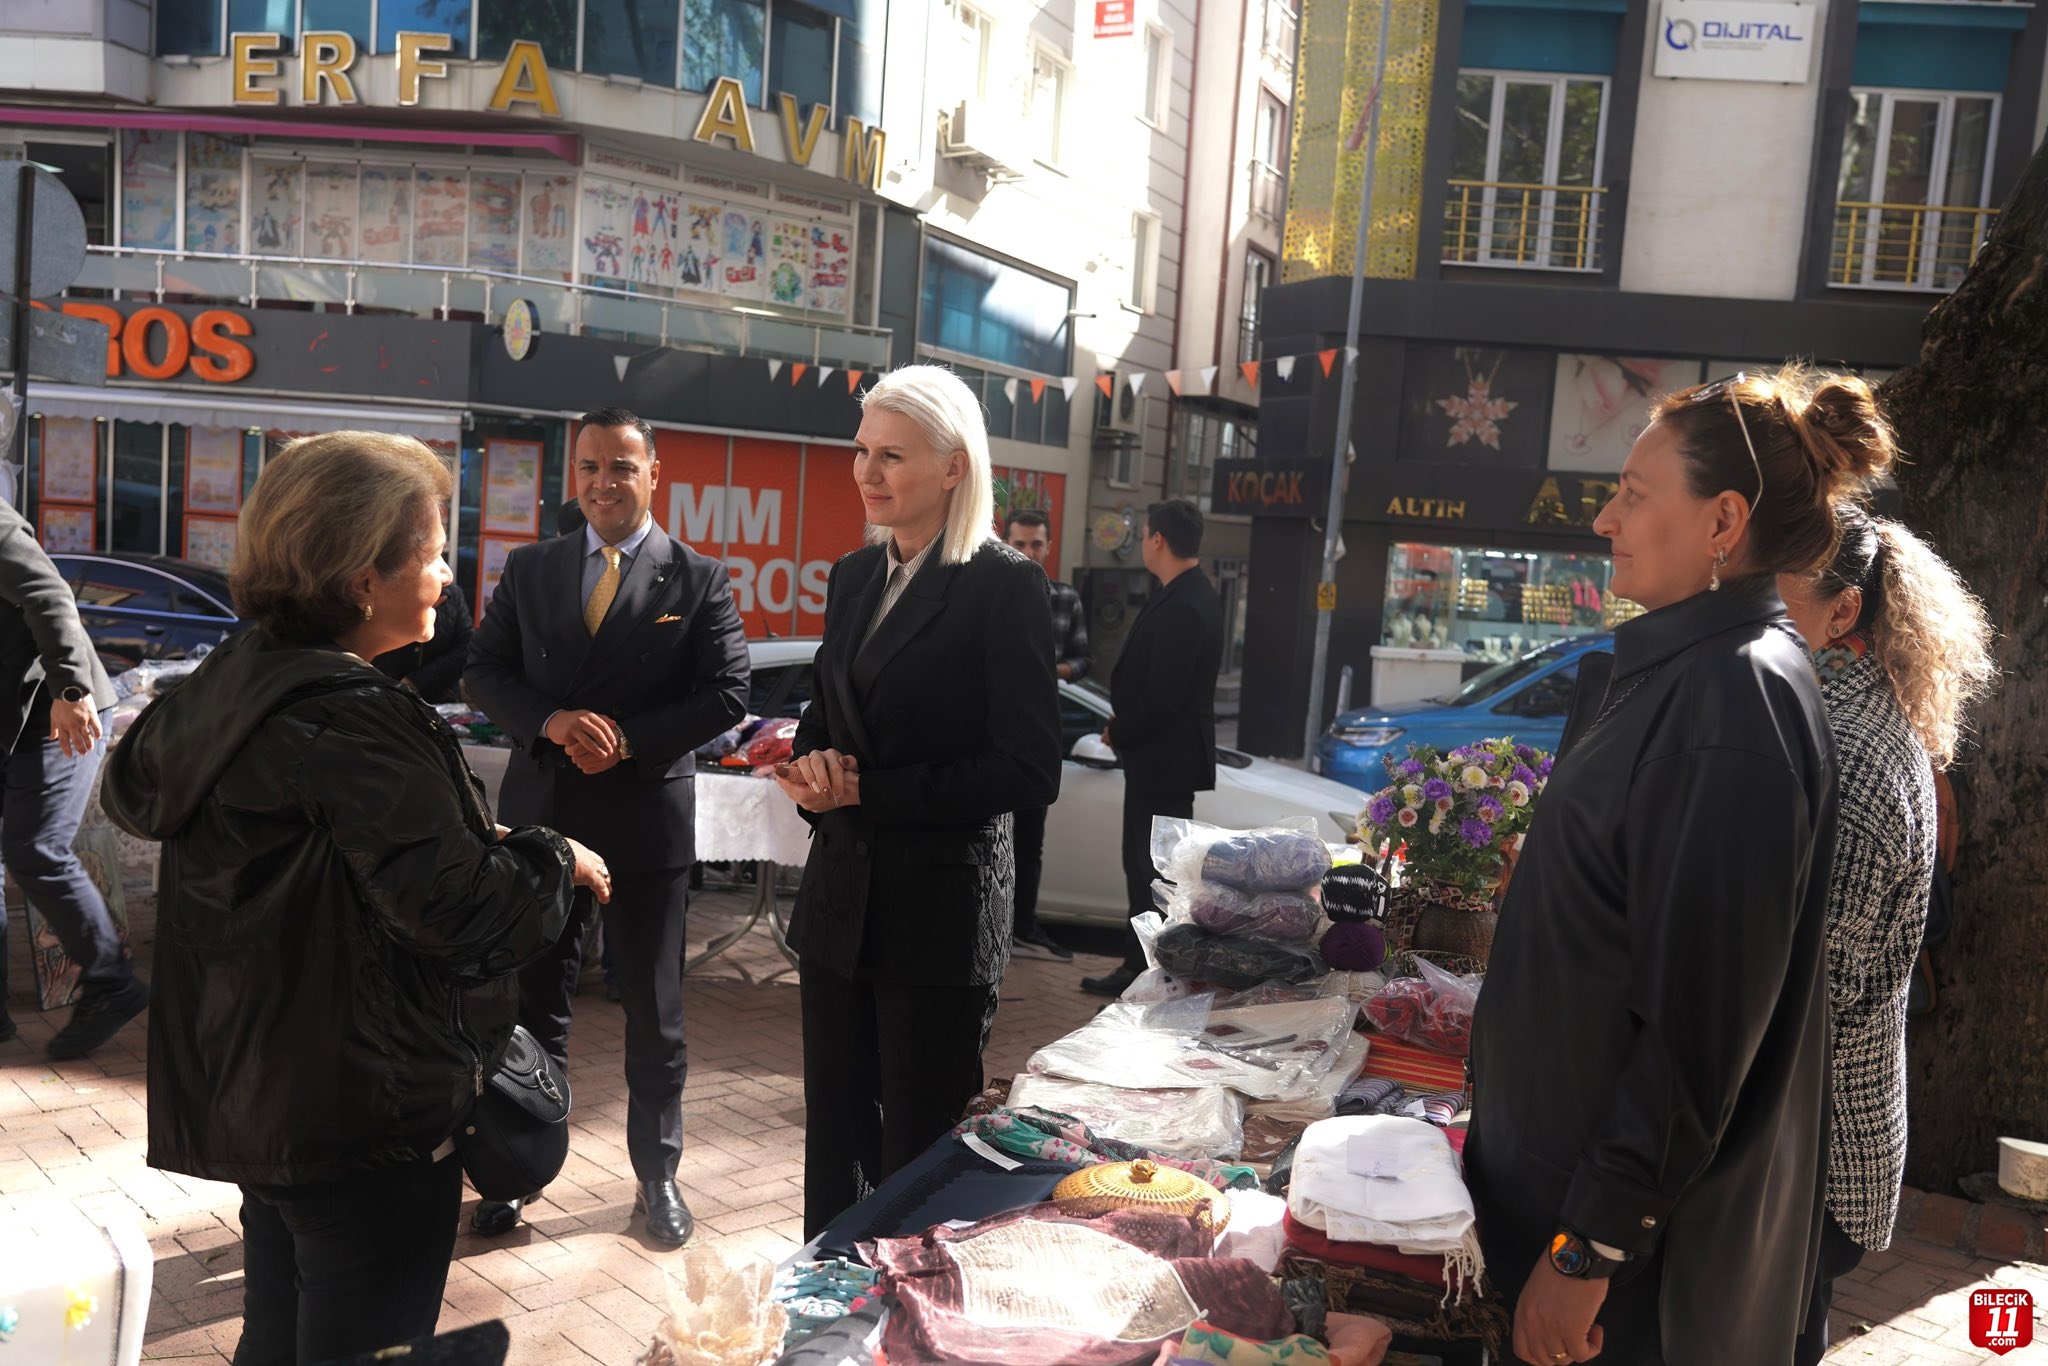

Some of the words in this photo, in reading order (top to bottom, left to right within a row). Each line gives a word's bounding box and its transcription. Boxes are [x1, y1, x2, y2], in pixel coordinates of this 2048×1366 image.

[231, 31, 563, 119] ERFA
[692, 75, 887, 194] AVM
[30, 300, 254, 382] ROS
[669, 482, 783, 546] MM
